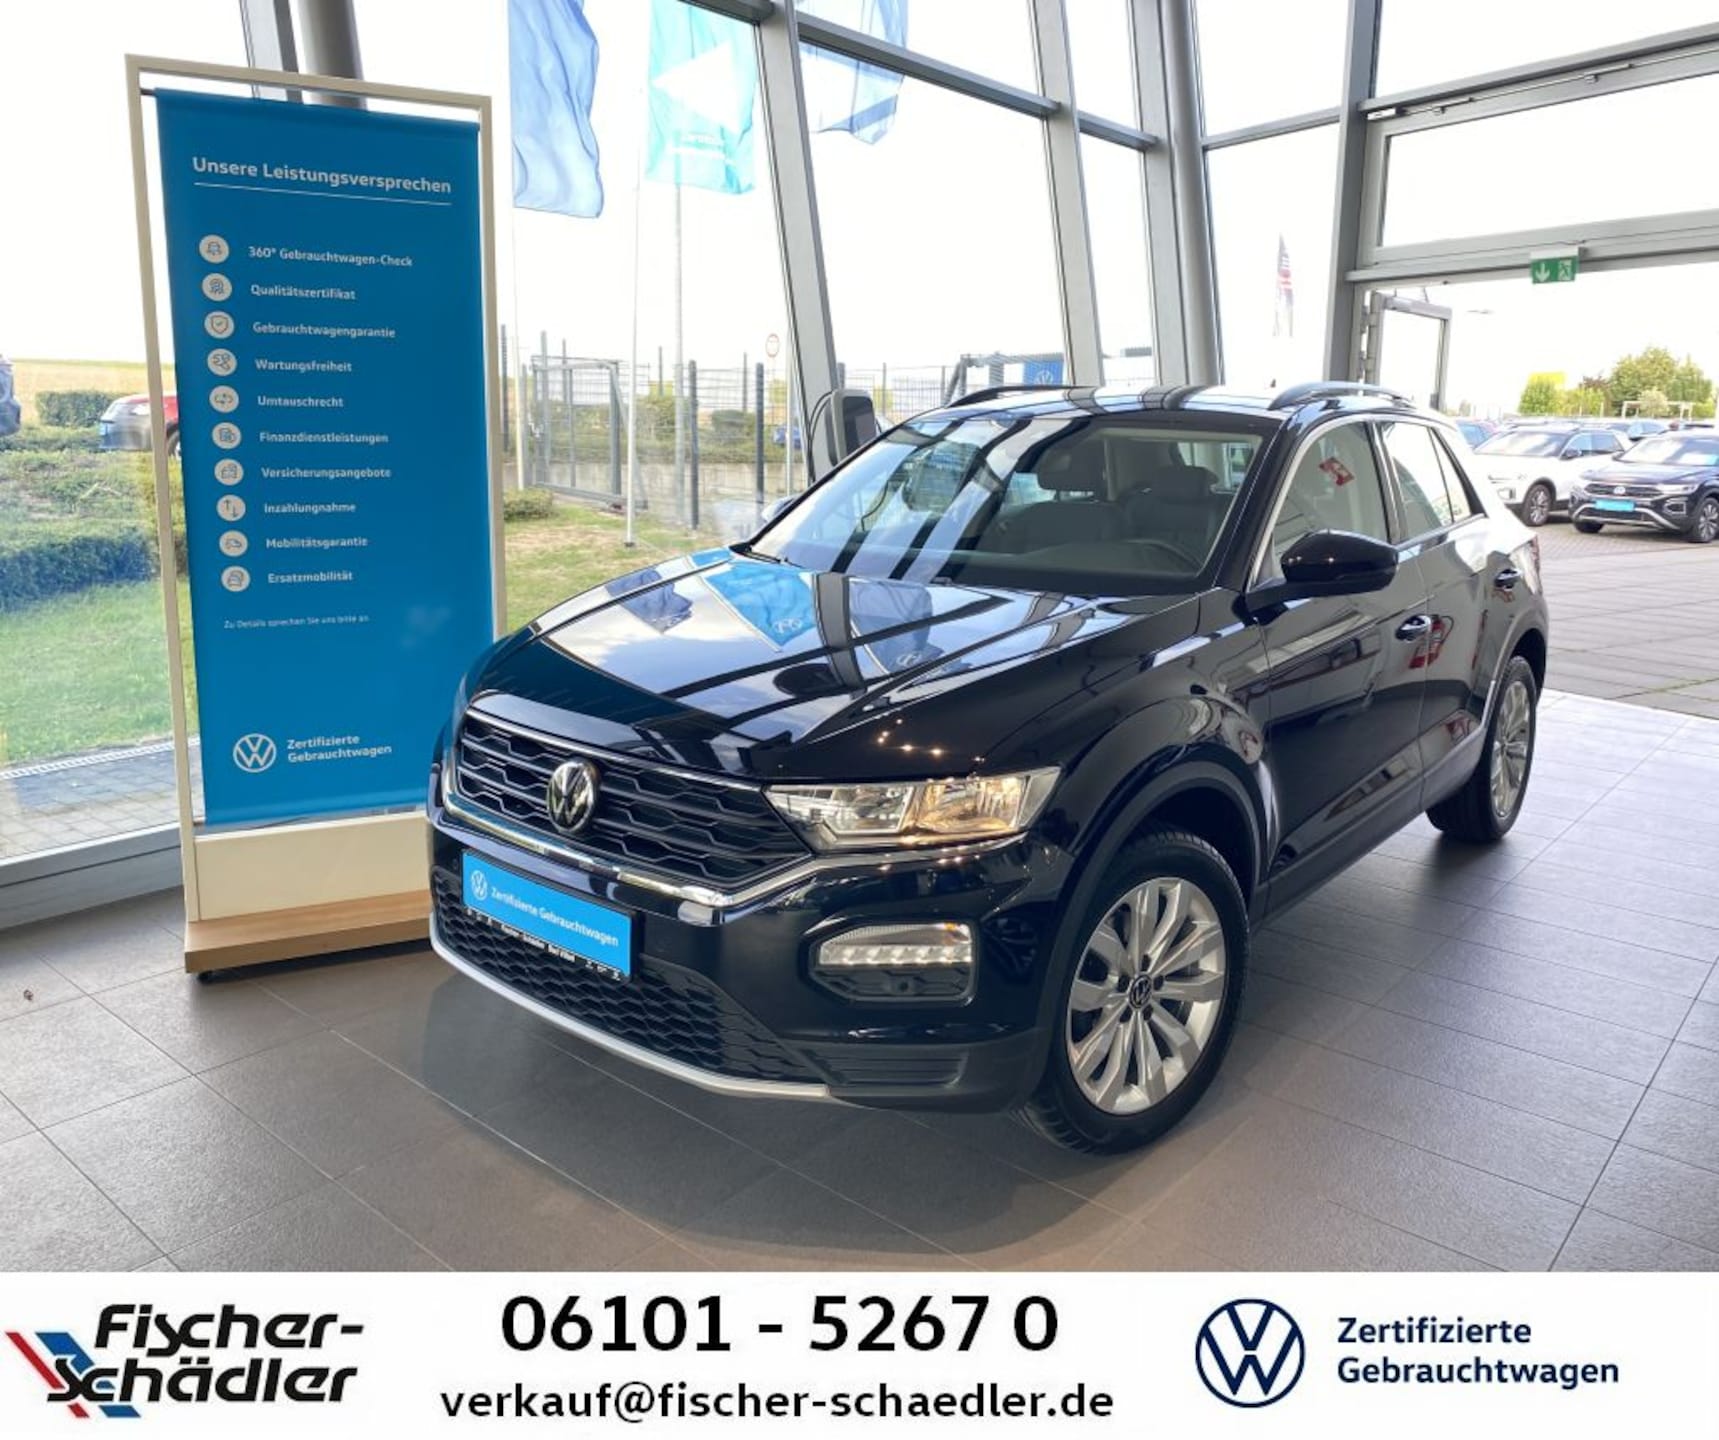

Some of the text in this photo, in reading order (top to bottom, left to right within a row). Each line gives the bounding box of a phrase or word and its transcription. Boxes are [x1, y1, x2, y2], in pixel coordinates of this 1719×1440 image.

[193, 156, 451, 193] Unsere Leistungsversprechen
[248, 246, 412, 266] 360° Gebrauchtwagen-Check
[250, 283, 355, 300] Qualitätszertifikat
[252, 321, 395, 339] Gebrauchtwagengarantie
[255, 358, 352, 373] Wartungsfreiheit
[257, 395, 343, 407] Umtauschrecht
[260, 431, 389, 445] Finanzdienstleistungen
[261, 467, 391, 480] Versicherungsangebote
[264, 502, 356, 515] Inzahlungnahme
[266, 536, 368, 550] Mobilitätsgarantie
[268, 571, 353, 584] Ersatzmobilität
[287, 734, 360, 750] Zertifizierte
[288, 744, 392, 764] Gebrauchtwagen
[491, 887, 538, 917] Zertifizierte
[539, 907, 618, 947] Gebrauchtwagen
